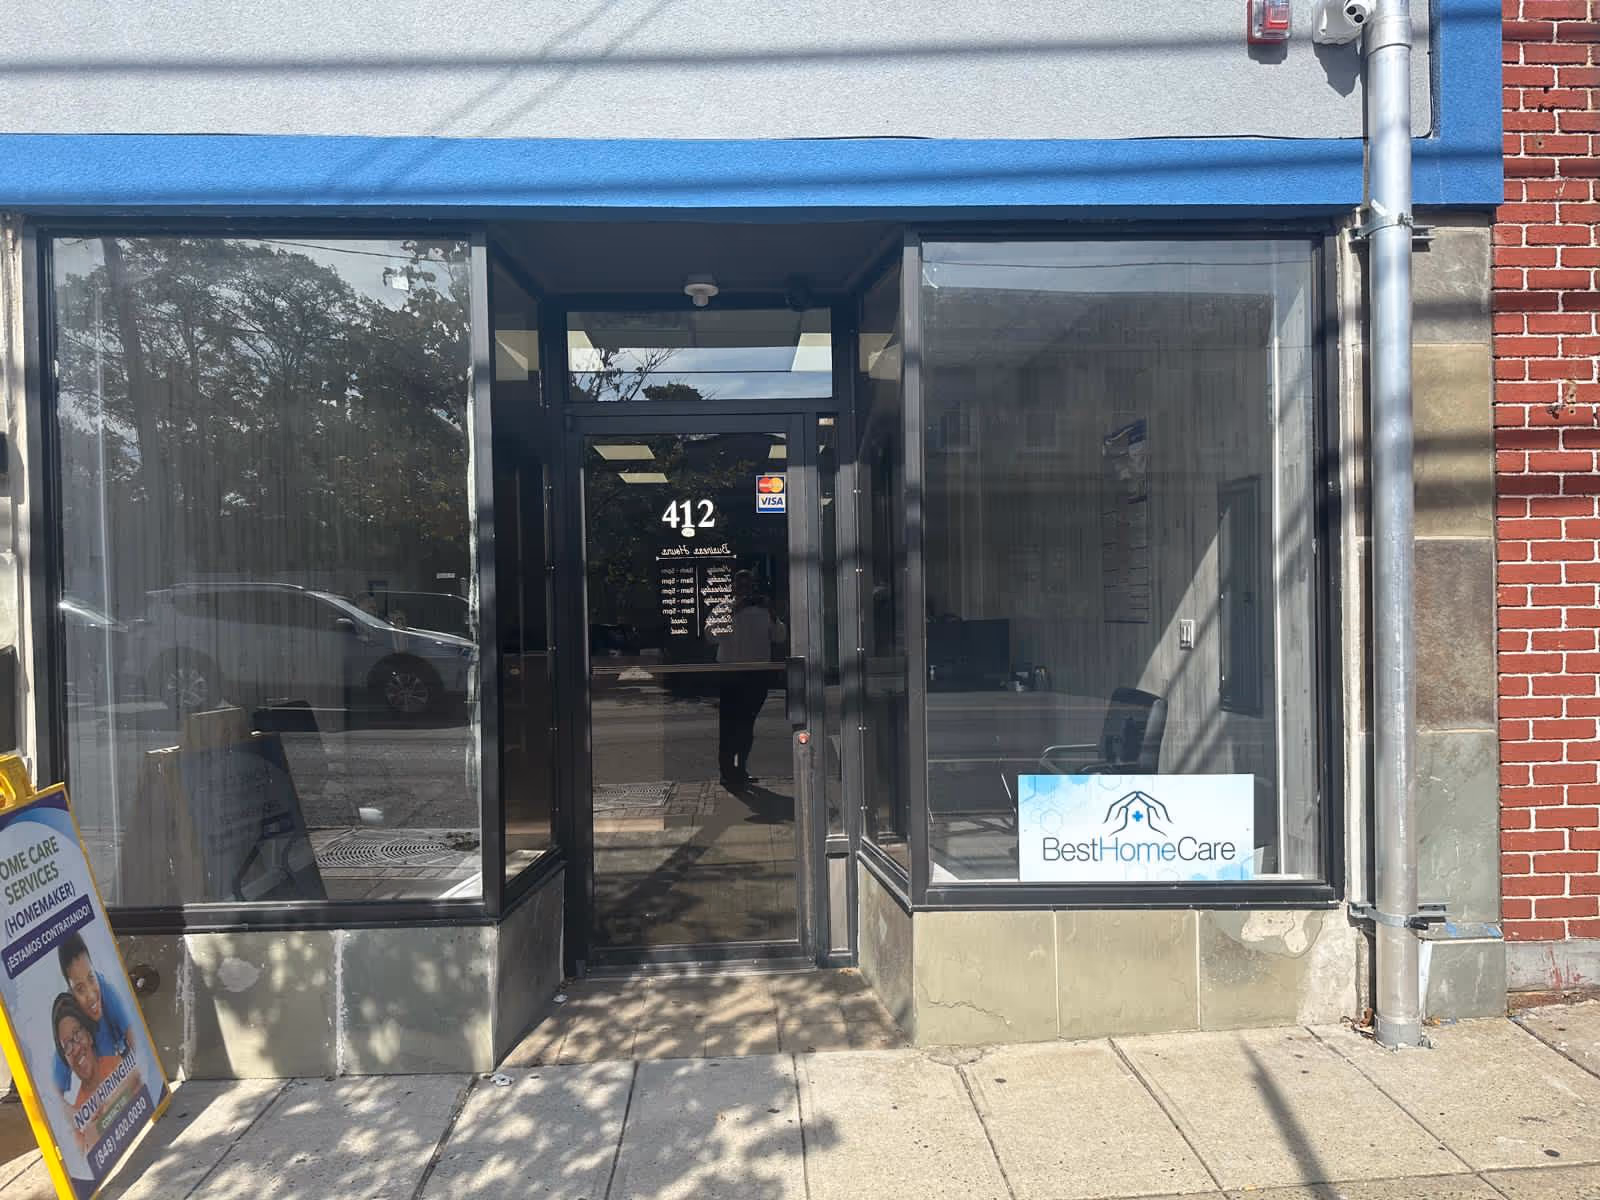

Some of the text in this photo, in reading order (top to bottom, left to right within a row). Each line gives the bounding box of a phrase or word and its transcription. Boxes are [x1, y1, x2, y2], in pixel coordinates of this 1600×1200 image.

[661, 499, 715, 528] 412
[761, 497, 783, 505] VISA
[0, 835, 59, 881] OME CARE
[1042, 836, 1235, 862] BestHomeCare
[4, 860, 59, 906] SERVICES
[4, 880, 76, 938] (HOMEMAKER)
[7, 903, 91, 974] ¡ESTAMOS CONTRATANDO!
[74, 1095, 97, 1129] NOW
[95, 1096, 147, 1169] (848) 400.0030
